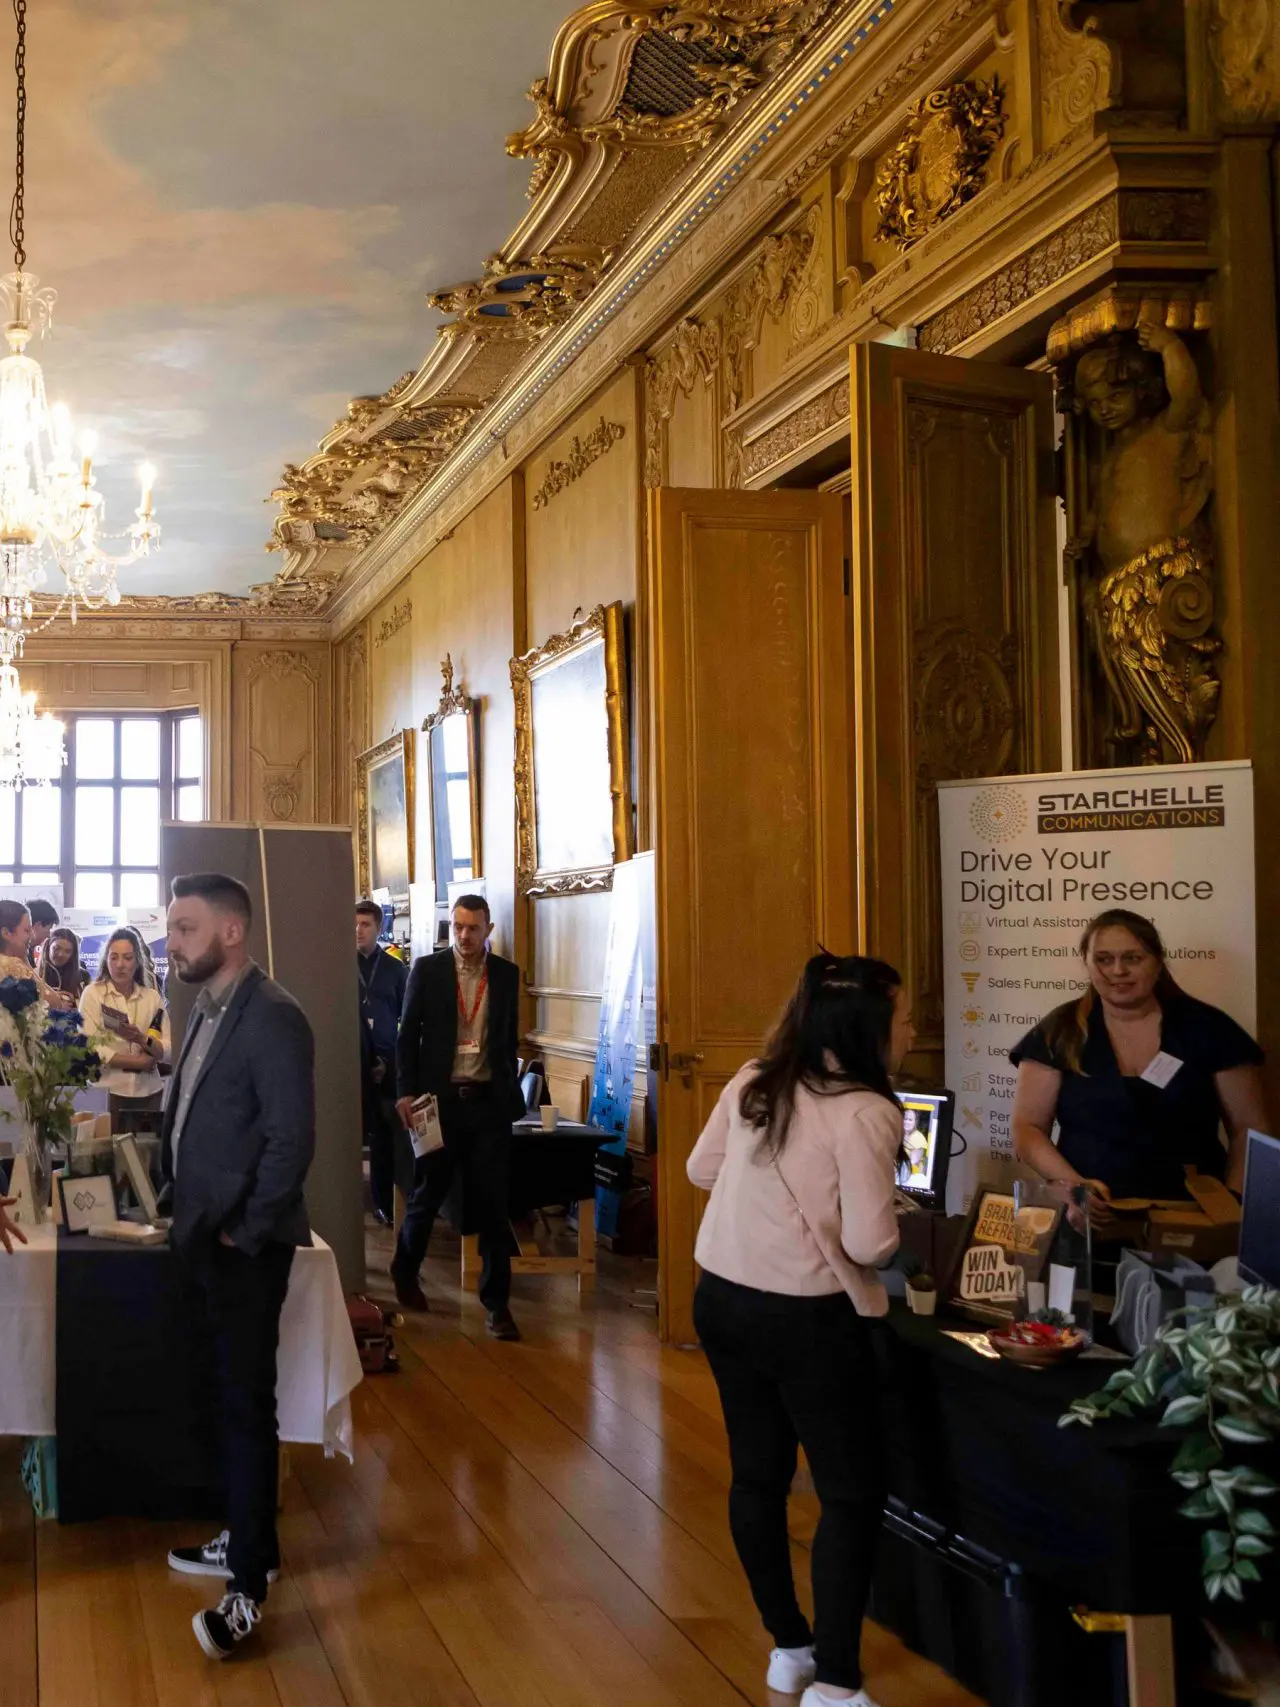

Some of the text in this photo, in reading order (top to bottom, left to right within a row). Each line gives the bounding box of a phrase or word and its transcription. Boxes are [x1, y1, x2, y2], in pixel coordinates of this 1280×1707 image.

[1038, 785, 1224, 812] STARCHELLE
[1042, 809, 1221, 831] COMMUNICATIONS
[961, 848, 1111, 872] Drive Your
[961, 878, 1214, 910] Digital Presence
[986, 916, 1029, 928] Virtual
[987, 946, 1029, 960] Expert
[1031, 946, 1068, 957] Email
[1164, 946, 1216, 960] lutions
[987, 977, 1020, 989] Sales
[1024, 978, 1066, 990] Funnel
[988, 1014, 1042, 1025] AI Traini
[968, 1250, 999, 1272] WIN
